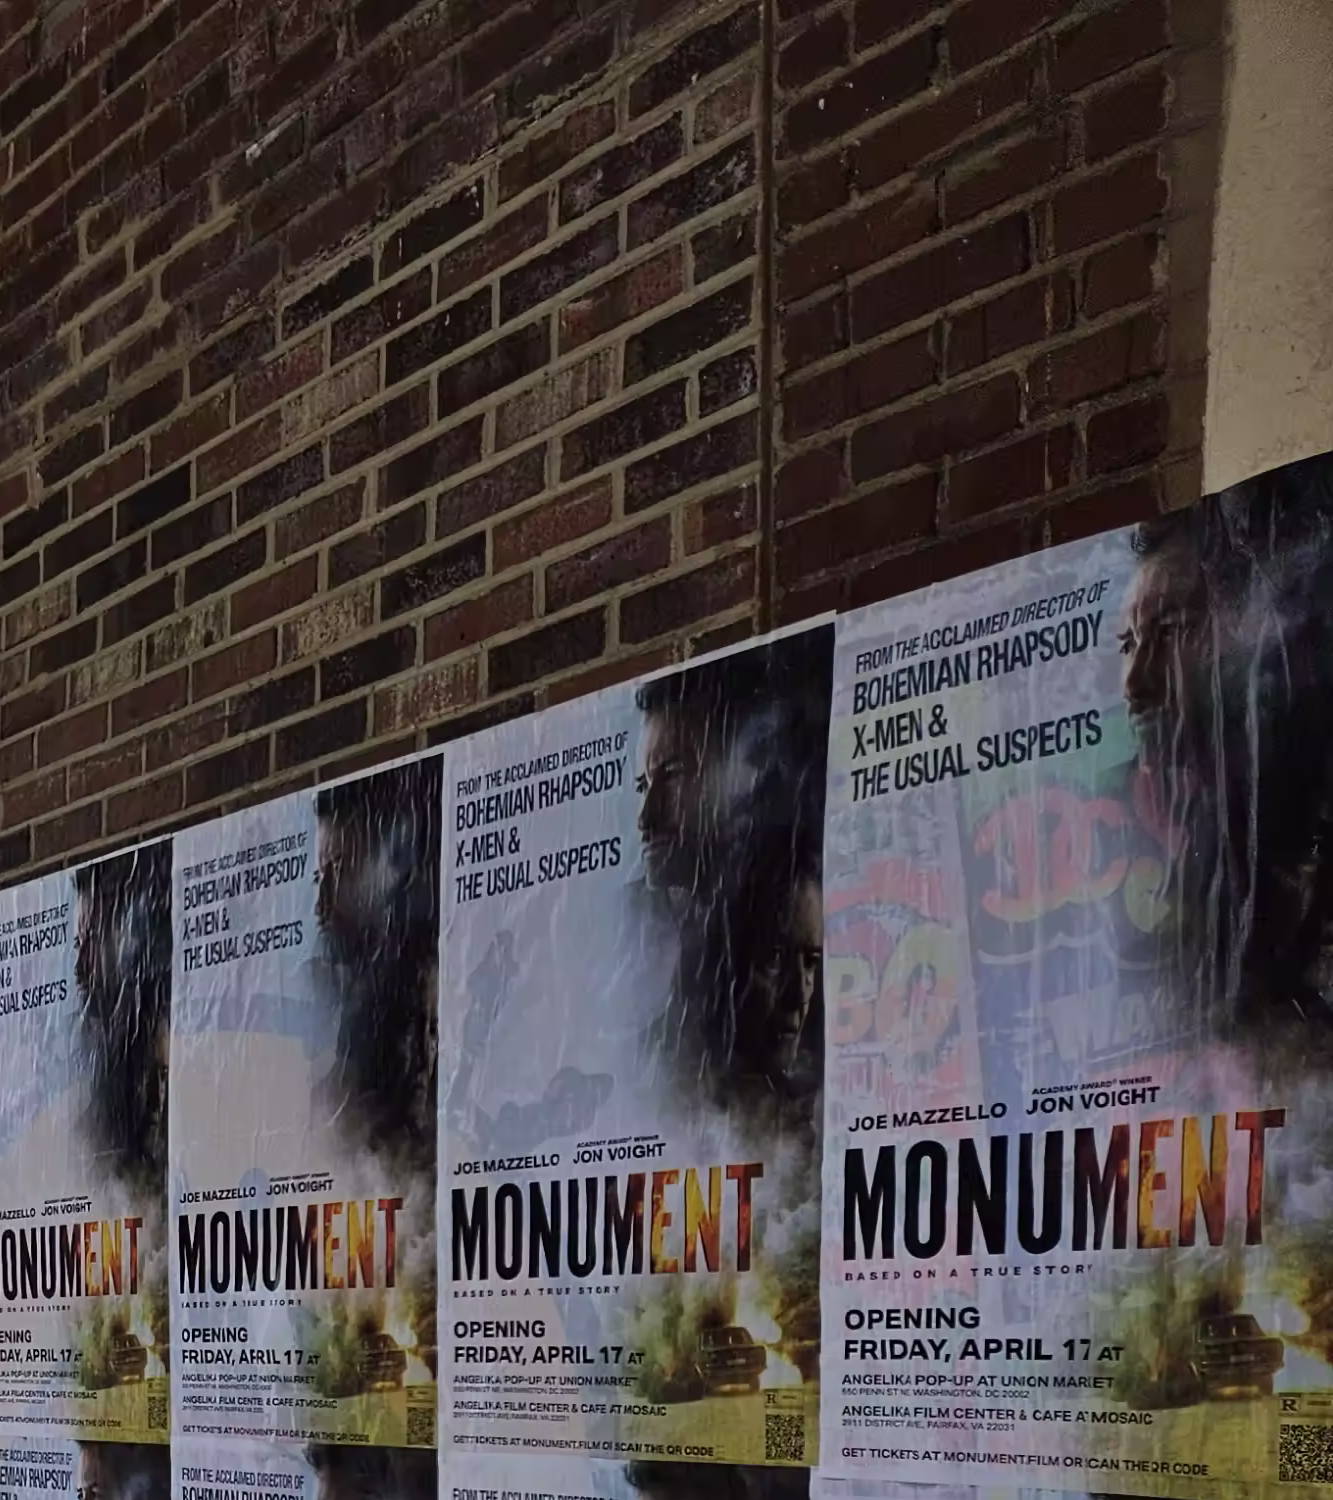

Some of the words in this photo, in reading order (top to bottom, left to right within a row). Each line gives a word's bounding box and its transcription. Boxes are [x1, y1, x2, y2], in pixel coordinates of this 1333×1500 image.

[853, 651, 971, 714] BOHEMIAN
[977, 611, 1104, 679] RHAPSODY
[852, 708, 923, 758] X-MEN
[927, 703, 948, 738] &
[850, 761, 890, 801] THE
[894, 743, 970, 790] USUAL
[977, 710, 1101, 771] SUSPECTS
[455, 784, 535, 831] BOHEMIAN
[537, 757, 627, 808] RHAPSODY
[455, 871, 483, 903] THE
[486, 860, 534, 896] USUAL
[537, 837, 621, 882] SUSPECTS
[848, 1114, 887, 1132] JOE
[892, 1102, 1007, 1127] MAZZELLO
[1025, 1094, 1074, 1115] JON
[1079, 1086, 1160, 1110] VOIGHT
[452, 1161, 481, 1176] JOE
[482, 1153, 560, 1172] MAZZELLO
[572, 1148, 603, 1164] JON
[607, 1142, 666, 1161] VOIGHT
[842, 1108, 1286, 1262] MONUMENT
[451, 1162, 764, 1282] MONUMENT
[178, 1197, 404, 1294] MONUMENT
[181, 1326, 248, 1343] OPENING
[453, 1319, 545, 1339] OPENING
[844, 1307, 980, 1330] OPENING
[24, 1348, 58, 1362] APRIL
[59, 1348, 72, 1362] 17
[181, 1348, 235, 1365] FRIDAY,
[283, 1349, 303, 1365] 17
[454, 1345, 527, 1366] FRIDAY,
[532, 1345, 594, 1364] APRIL
[599, 1346, 623, 1364] 17
[627, 1352, 645, 1364] AT
[844, 1338, 952, 1363] FRIDAY,
[959, 1338, 1054, 1361] APRIL
[1061, 1338, 1090, 1360] 17
[1097, 1346, 1123, 1361] AT
